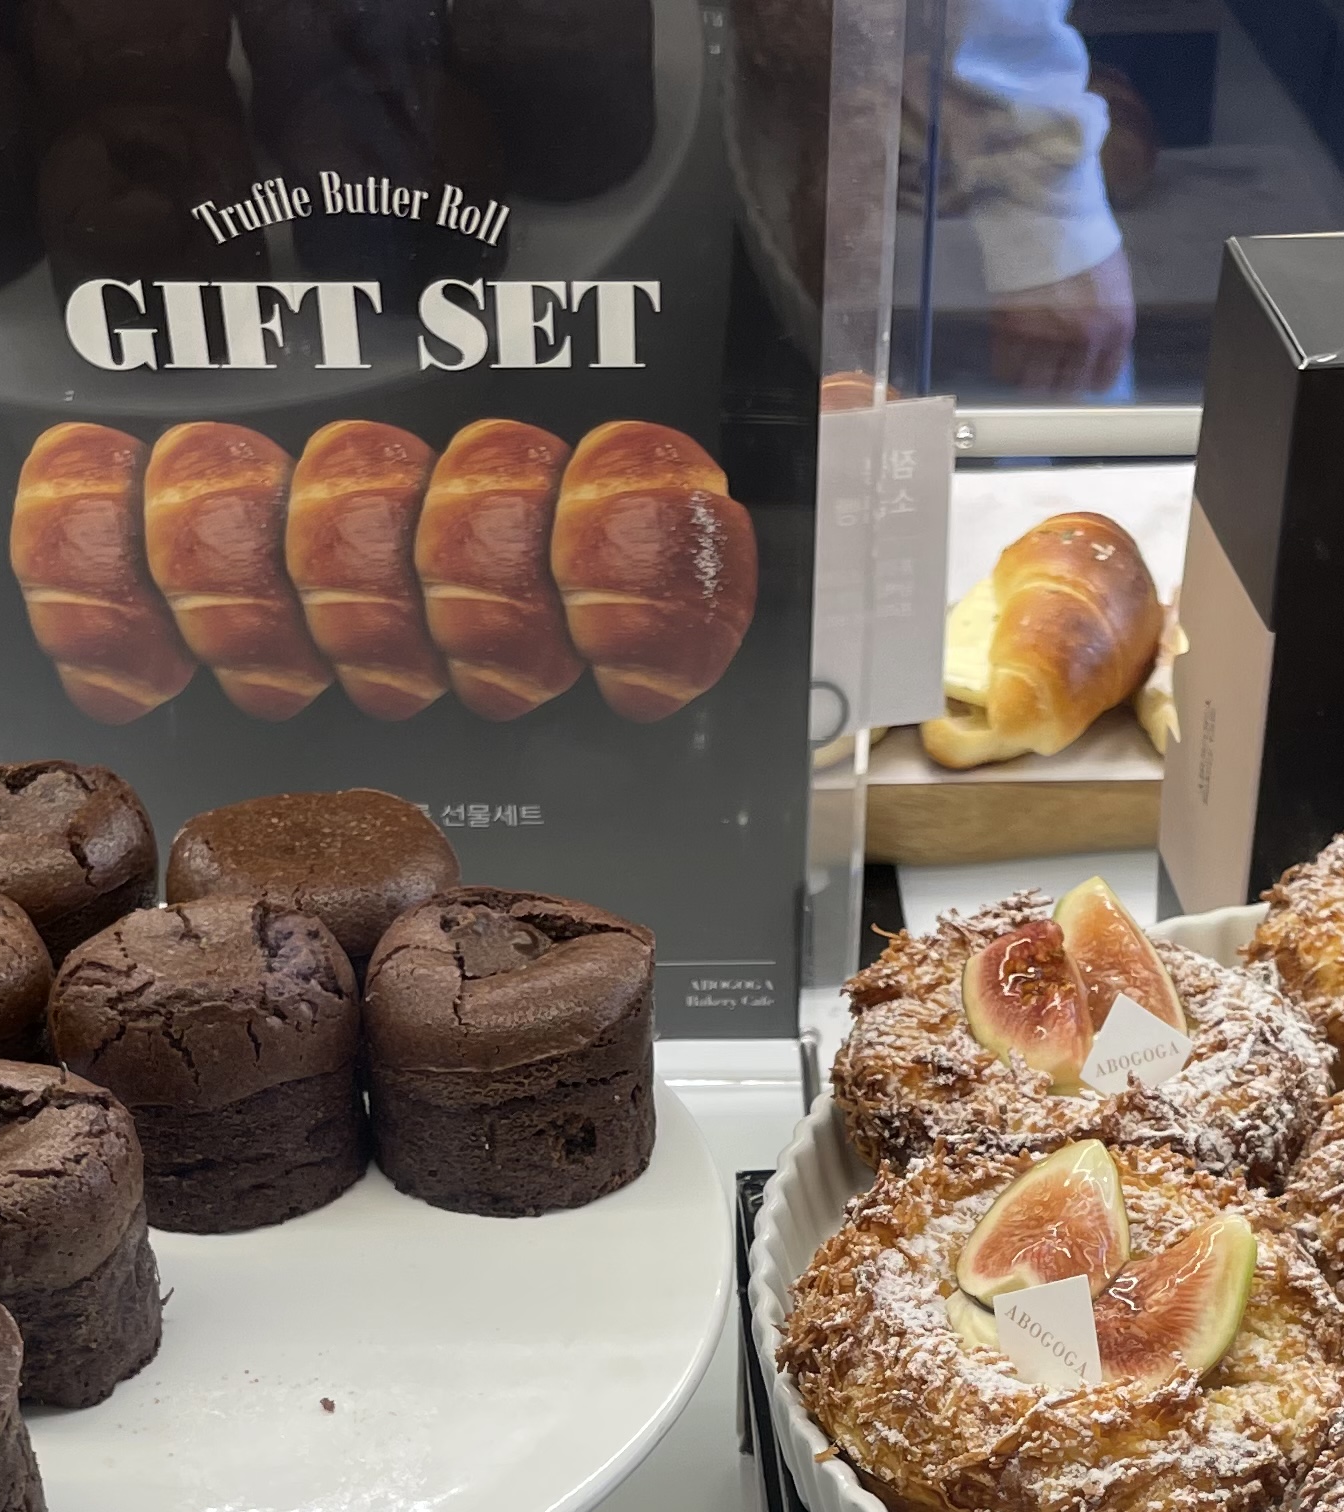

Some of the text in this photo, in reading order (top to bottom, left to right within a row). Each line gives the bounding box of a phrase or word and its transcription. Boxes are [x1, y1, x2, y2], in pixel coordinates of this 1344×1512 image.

[191, 170, 510, 246] Truffle Butter Roll
[64, 277, 661, 372] GIFT SET
[441, 803, 544, 828] 선물세트
[1096, 1040, 1180, 1078] ABOGOGA
[1005, 1304, 1089, 1378] ABOGOGA
